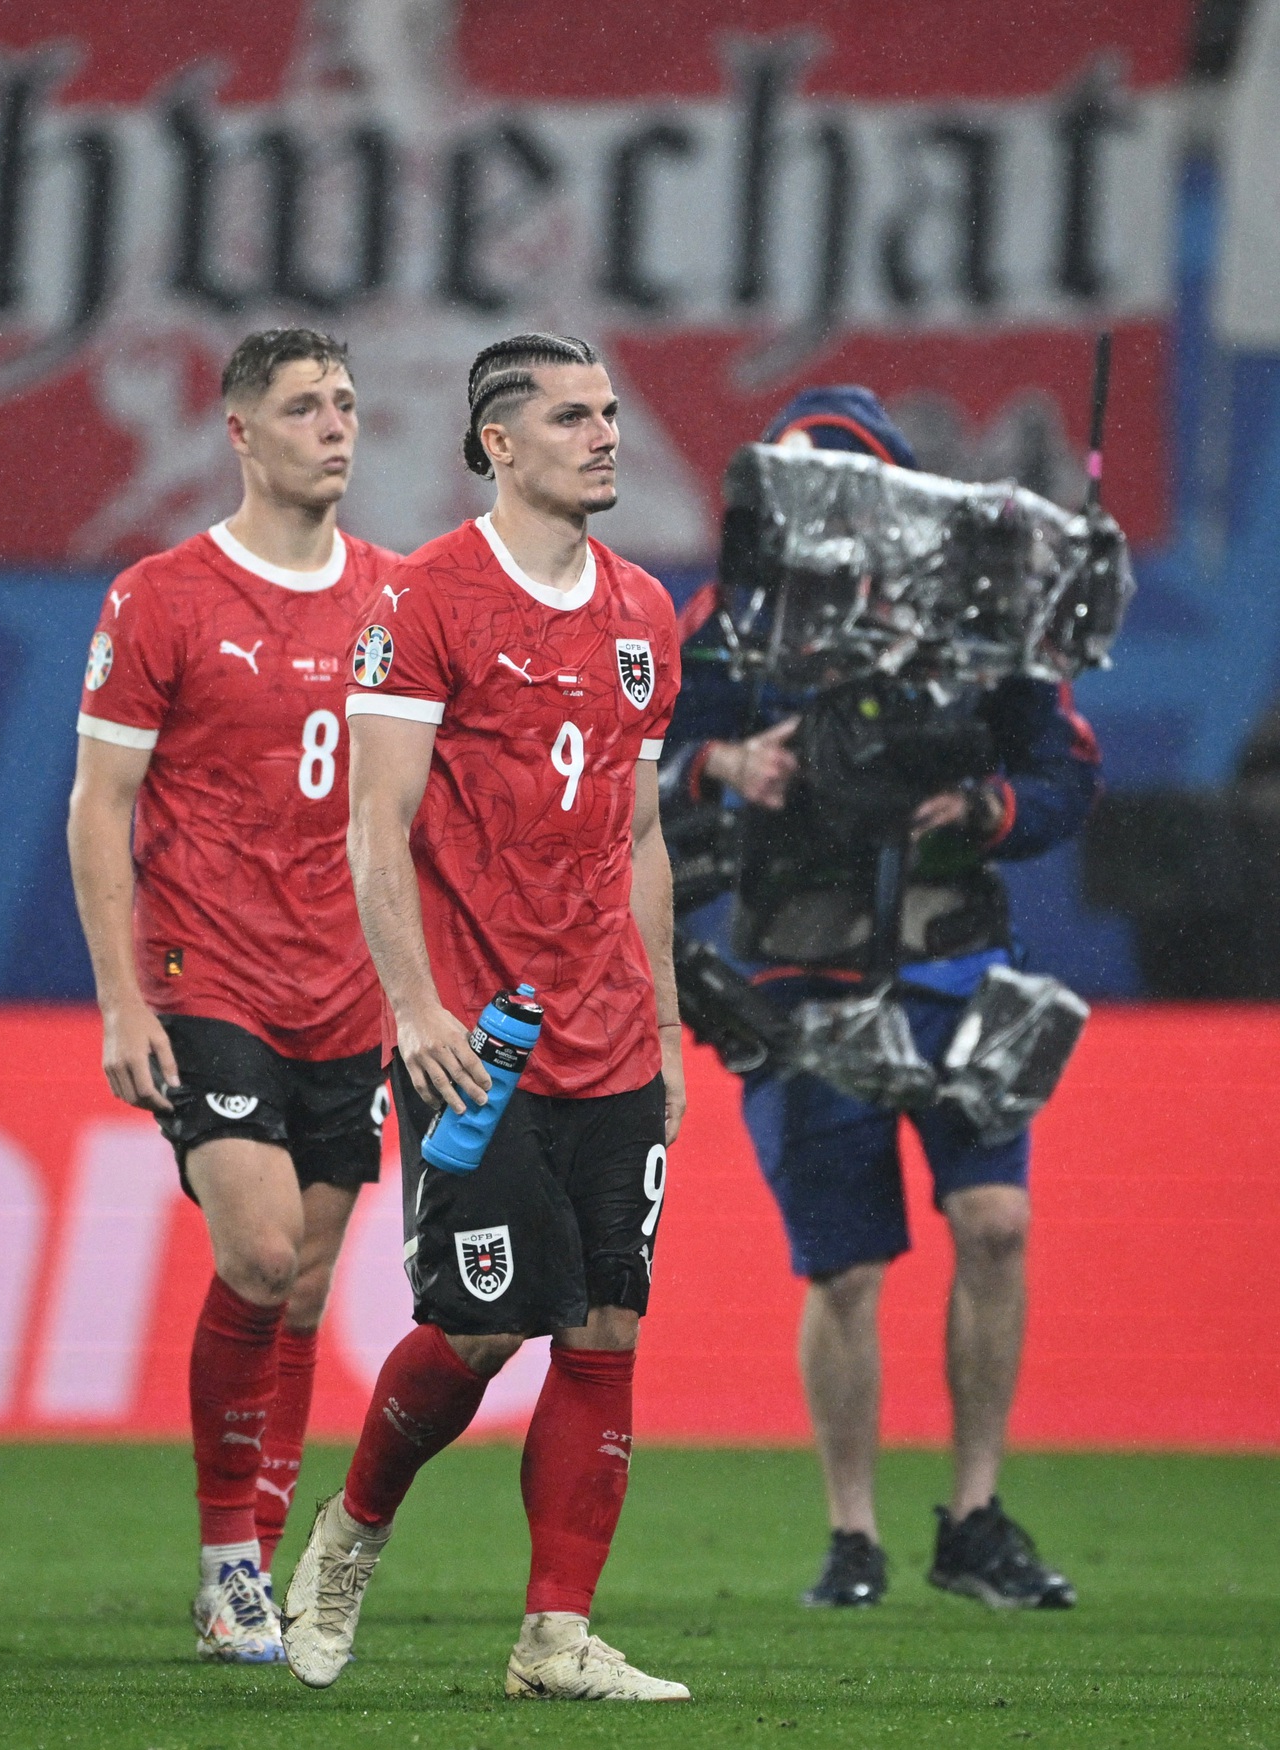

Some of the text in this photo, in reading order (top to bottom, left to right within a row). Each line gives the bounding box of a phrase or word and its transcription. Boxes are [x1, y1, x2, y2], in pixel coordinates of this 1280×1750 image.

[297, 708, 341, 801] 8
[550, 720, 585, 812] 9
[641, 1143, 667, 1237] 9
[470, 1232, 493, 1242] ÖFB
[602, 1430, 633, 1445] ÖF
